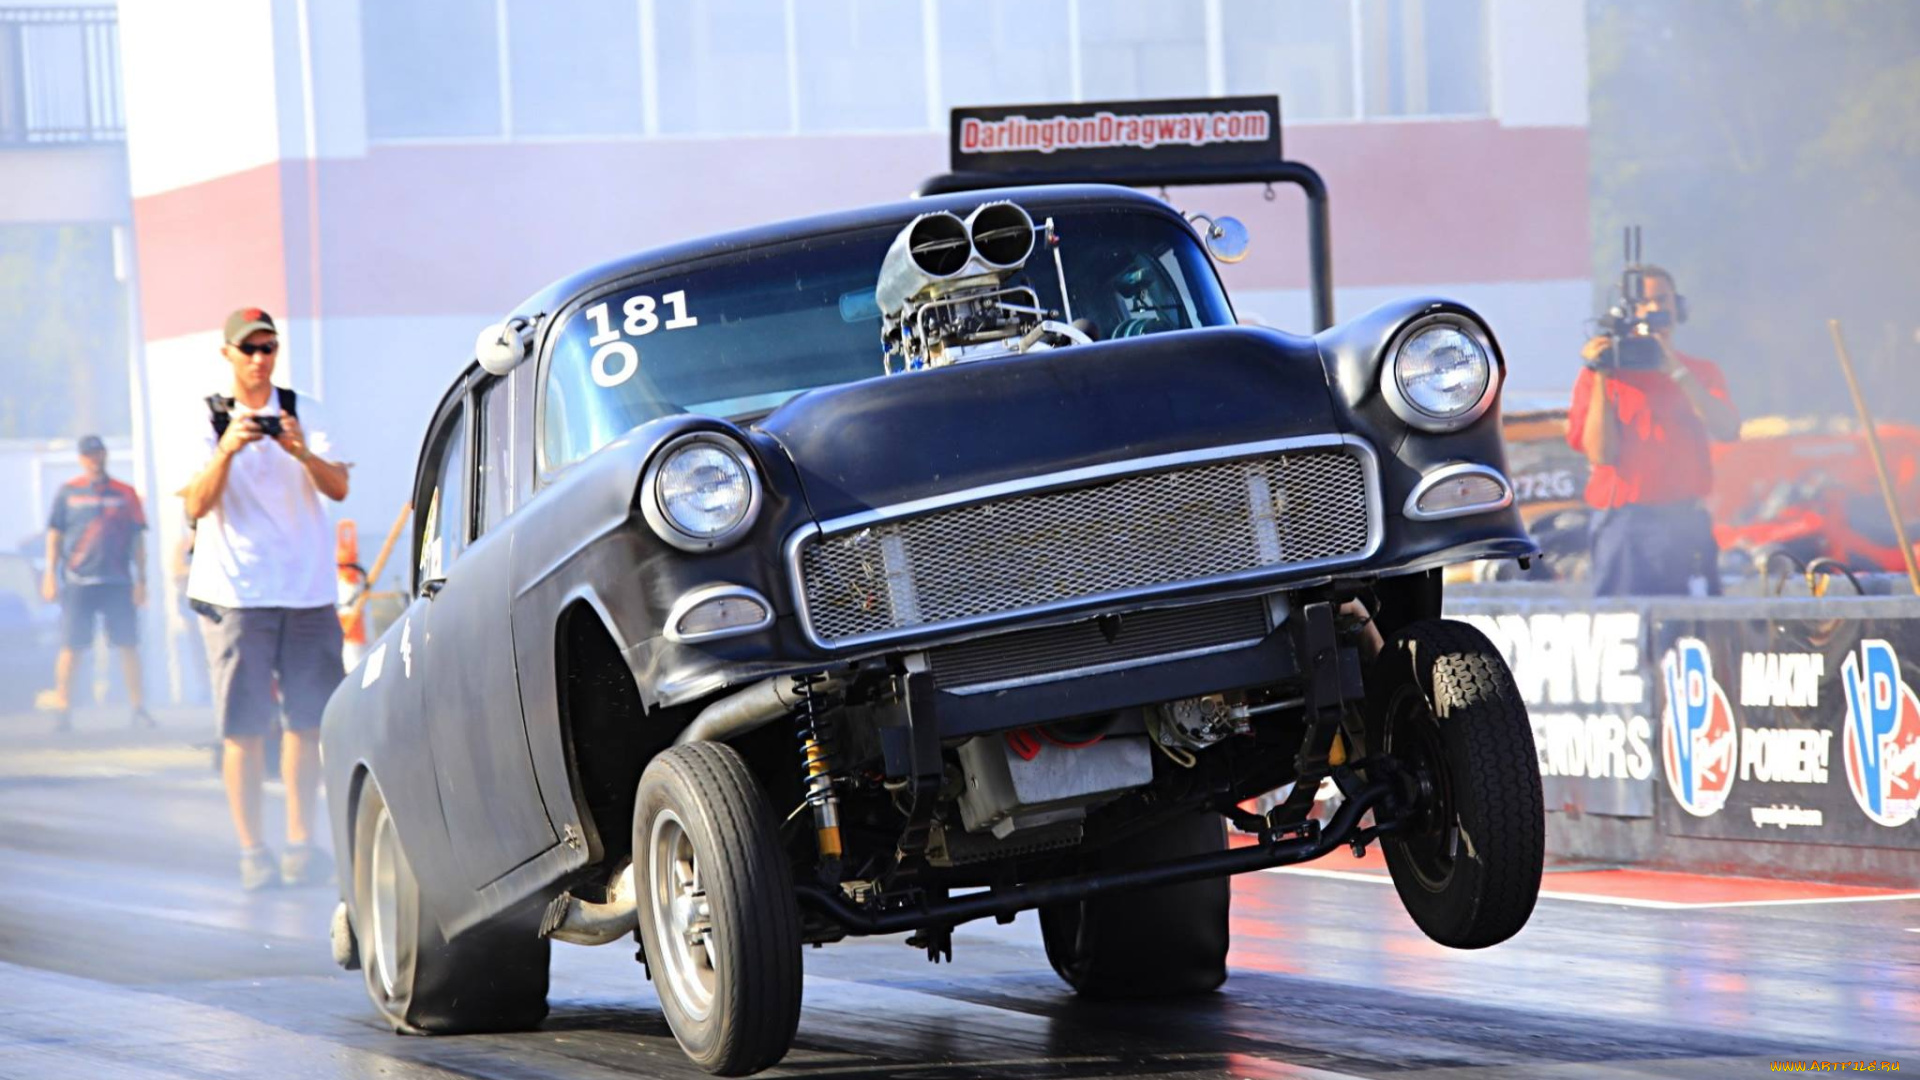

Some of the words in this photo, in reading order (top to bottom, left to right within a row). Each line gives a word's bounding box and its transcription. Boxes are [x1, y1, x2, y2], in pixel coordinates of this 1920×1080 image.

[961, 111, 1270, 153] DarlingtonDragway.com
[586, 289, 698, 348] 181
[1527, 712, 1652, 780] ENDORS
